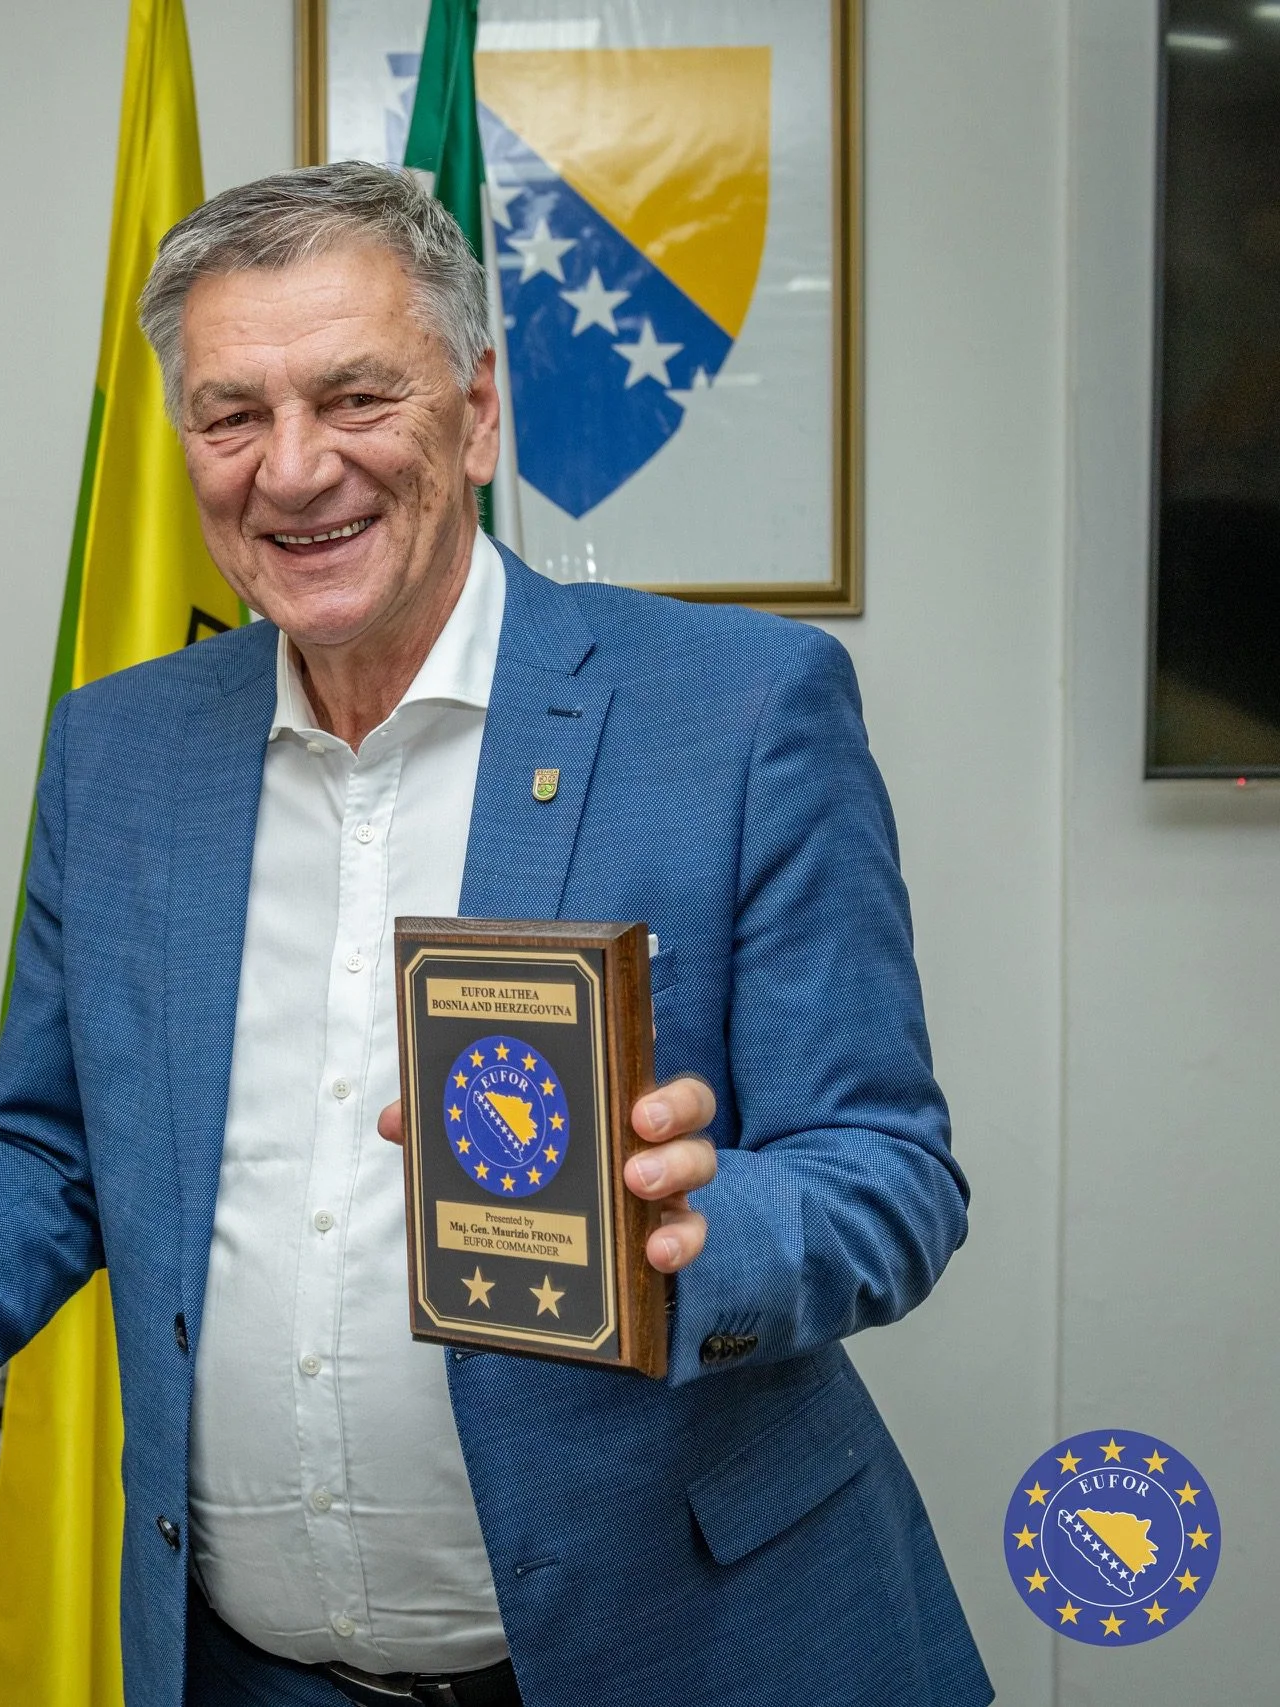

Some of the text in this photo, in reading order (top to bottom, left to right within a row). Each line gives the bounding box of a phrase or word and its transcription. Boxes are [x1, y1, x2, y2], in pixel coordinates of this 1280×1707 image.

[461, 986, 539, 1000] EUFOR ALTHEA
[432, 999, 572, 1017] BOSNIA AND HERZEGOVINA
[480, 1070, 529, 1093] EUFOR
[485, 1211, 534, 1229] Presented by
[449, 1221, 573, 1245] Maj. Gen. Maurizio FRONDA
[463, 1236, 559, 1257] EUFOR COMMANDER
